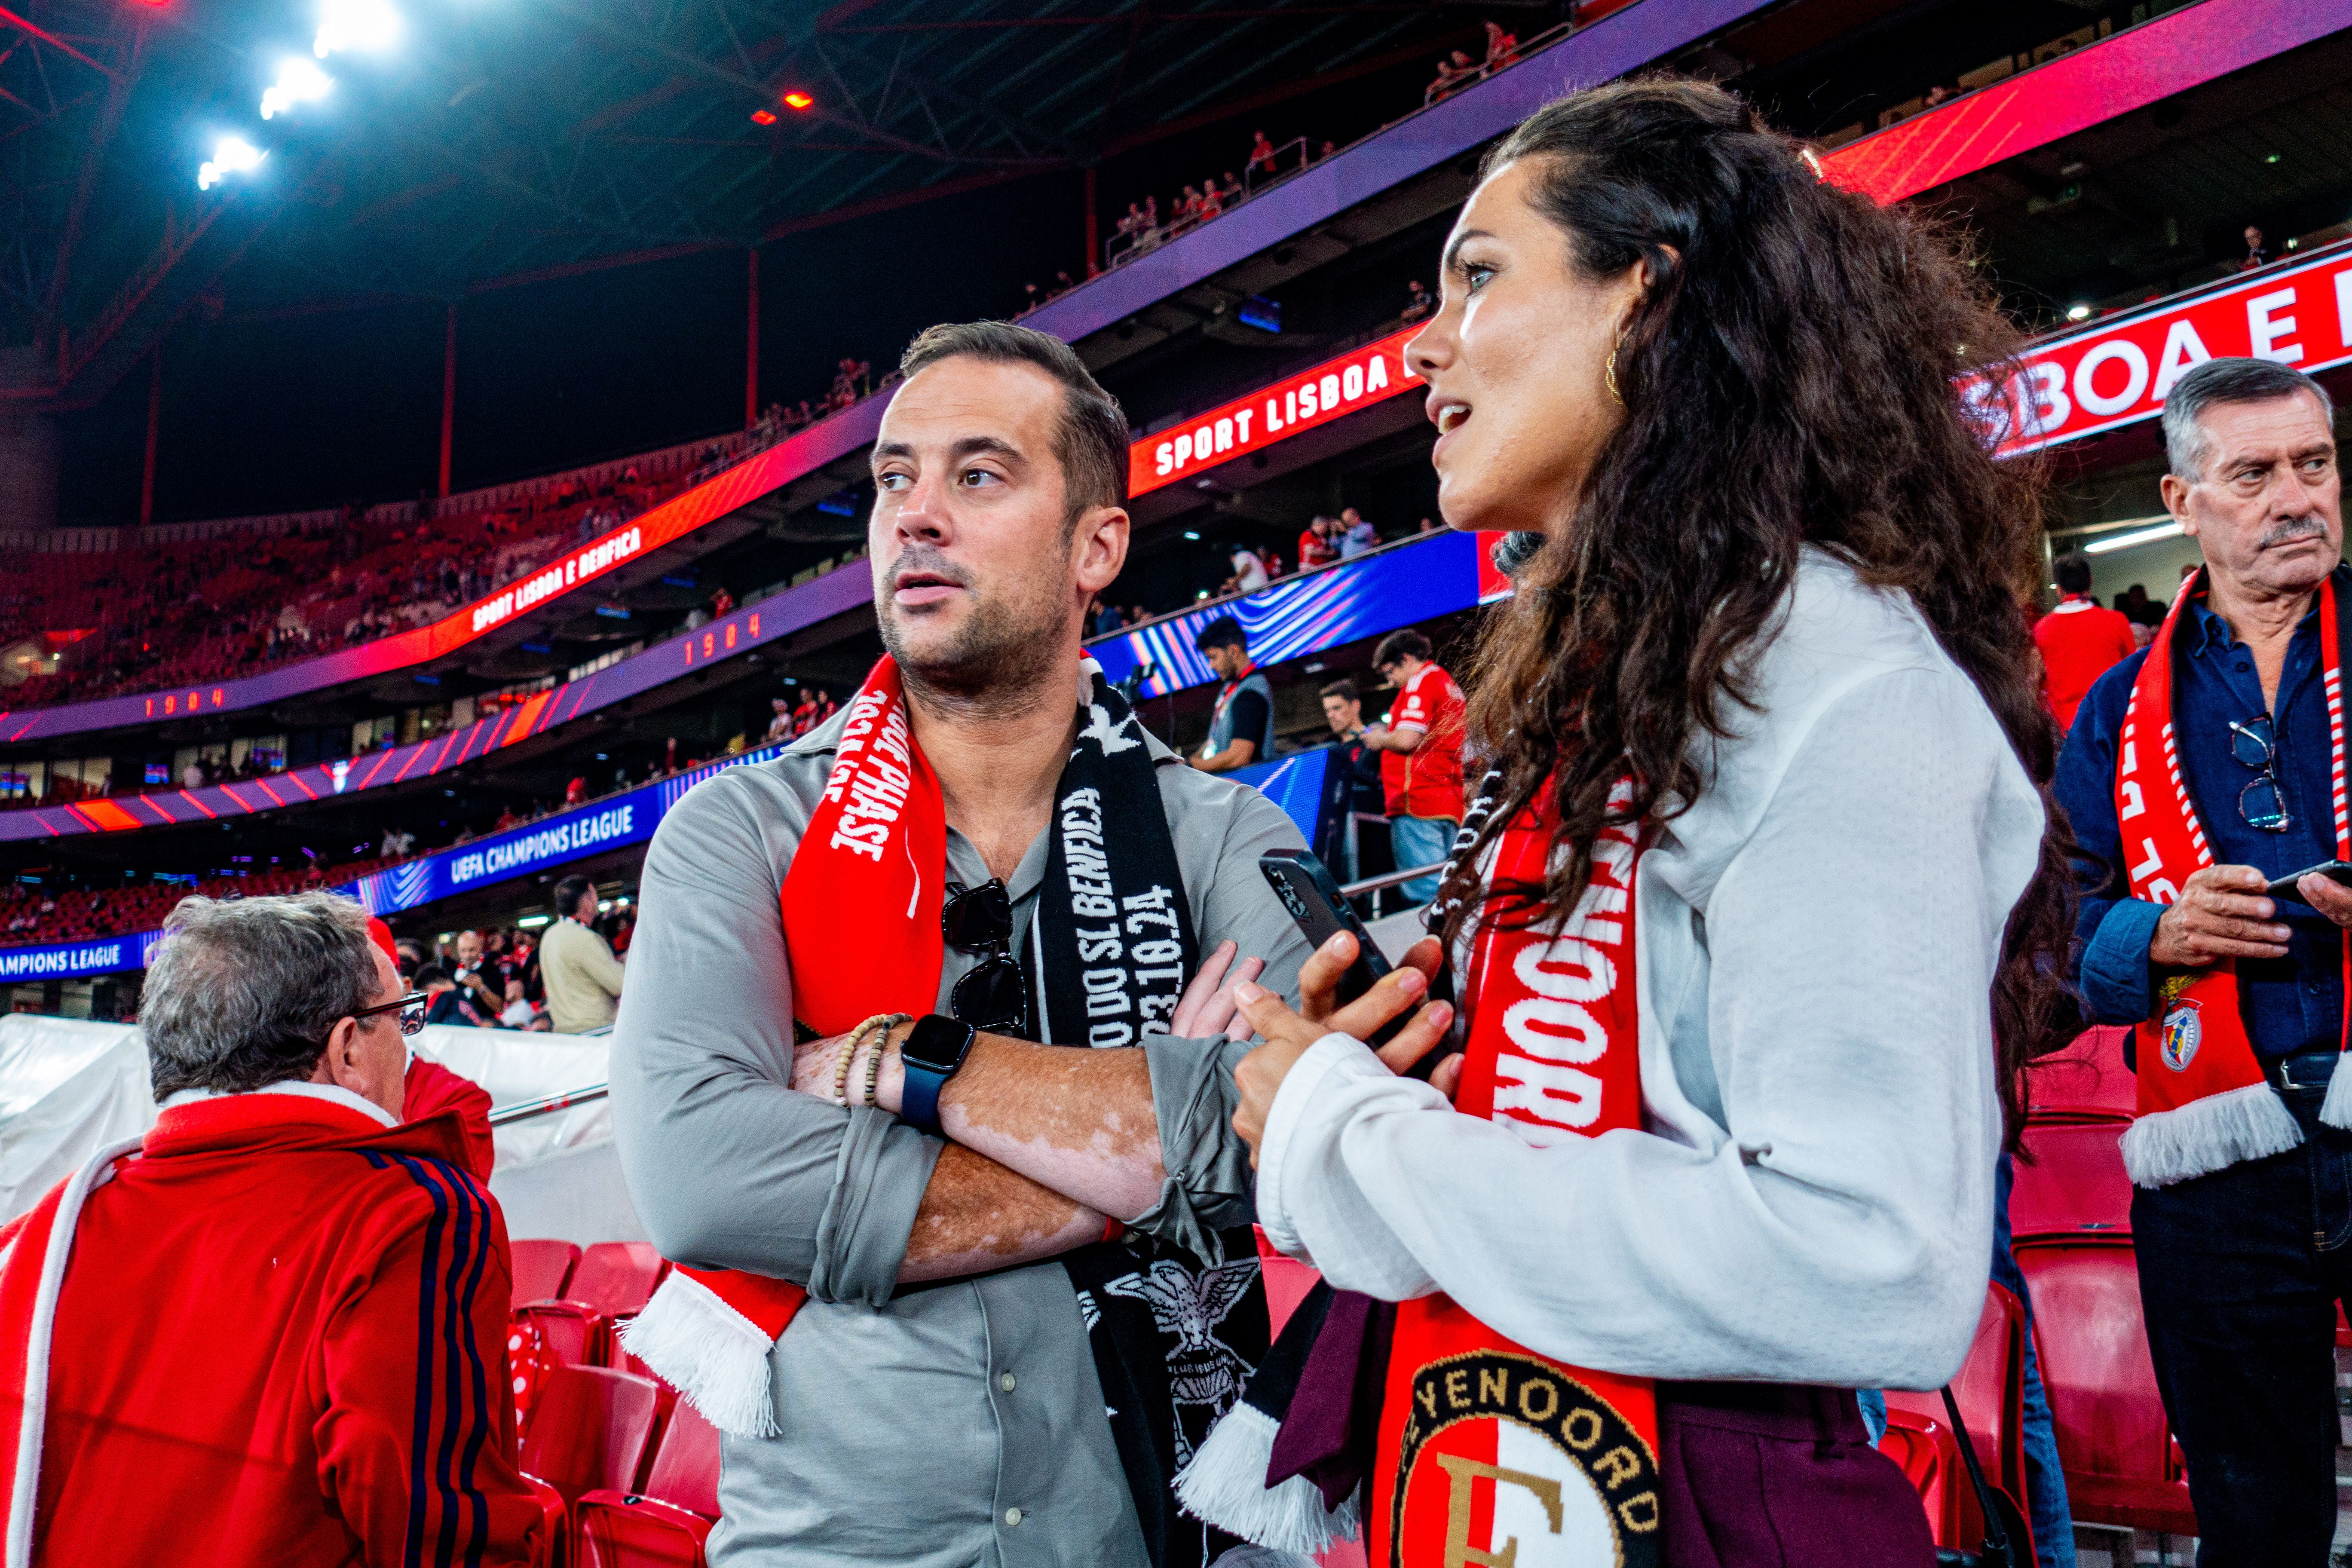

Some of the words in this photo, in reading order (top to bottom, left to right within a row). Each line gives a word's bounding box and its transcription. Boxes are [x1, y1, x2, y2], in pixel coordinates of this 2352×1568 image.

[2247, 287, 2304, 364] E
[1155, 408, 1253, 476] SPORT
[1267, 355, 1388, 432] LISBOA
[473, 593, 513, 632] SPORT
[566, 560, 576, 584] E
[579, 527, 640, 578] BENFICA
[451, 852, 484, 884] UEFA
[486, 825, 570, 874] CHAMPIONS
[571, 805, 634, 849] LEAGUE
[830, 754, 910, 862] PHASE
[1062, 787, 1117, 917] BENFICA
[70, 944, 120, 970] LEAGUE
[1077, 923, 1123, 962] SL
[1082, 968, 1130, 1017] DO
[1402, 1368, 1658, 1532] YENOORD
